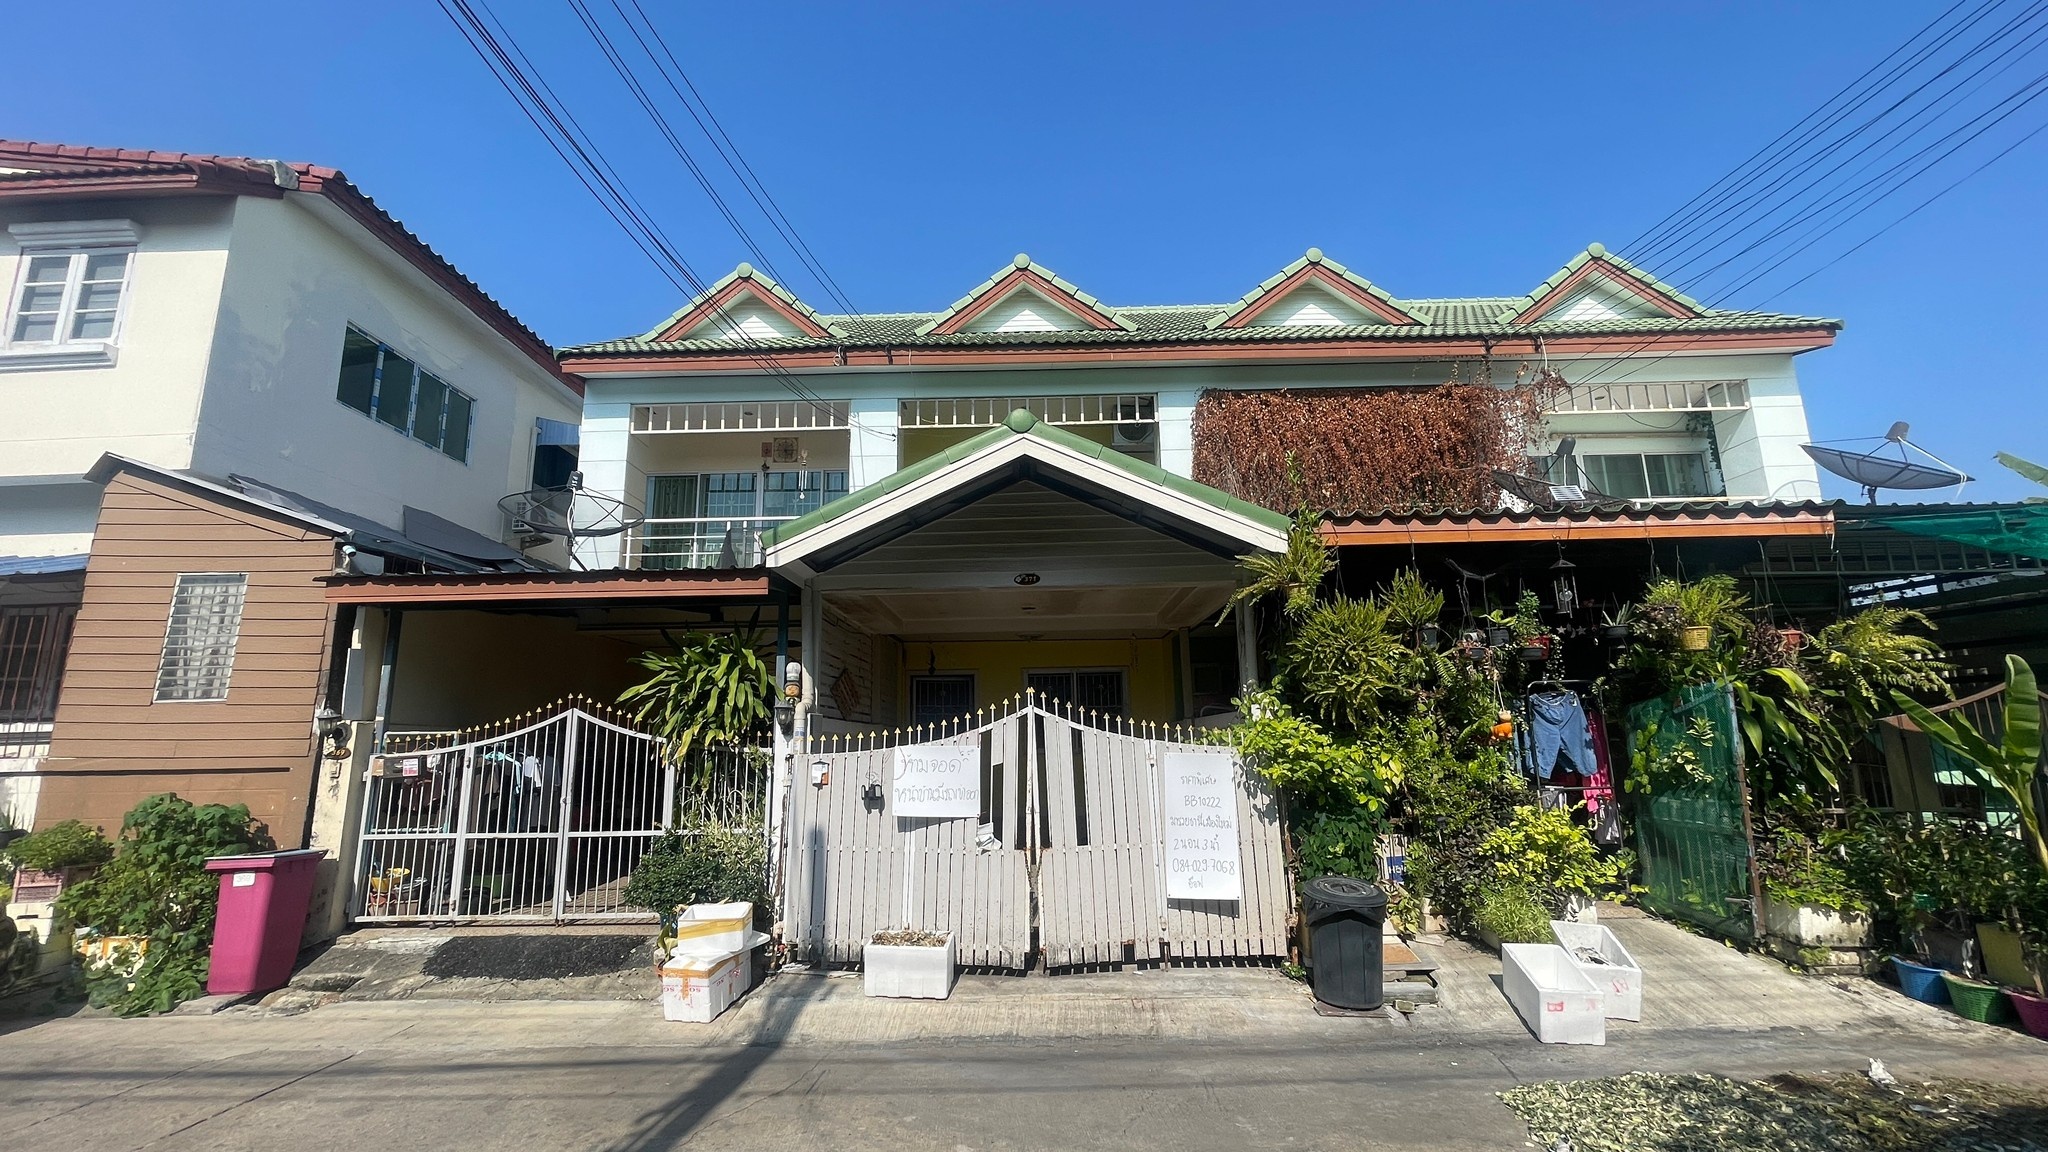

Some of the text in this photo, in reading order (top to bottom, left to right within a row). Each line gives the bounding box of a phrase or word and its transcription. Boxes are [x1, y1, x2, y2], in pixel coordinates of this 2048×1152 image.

[901, 754, 962, 774] ห้ามจอด
[1184, 794, 1222, 809] BB10222
[1172, 858, 1235, 876] 084-029-7068
